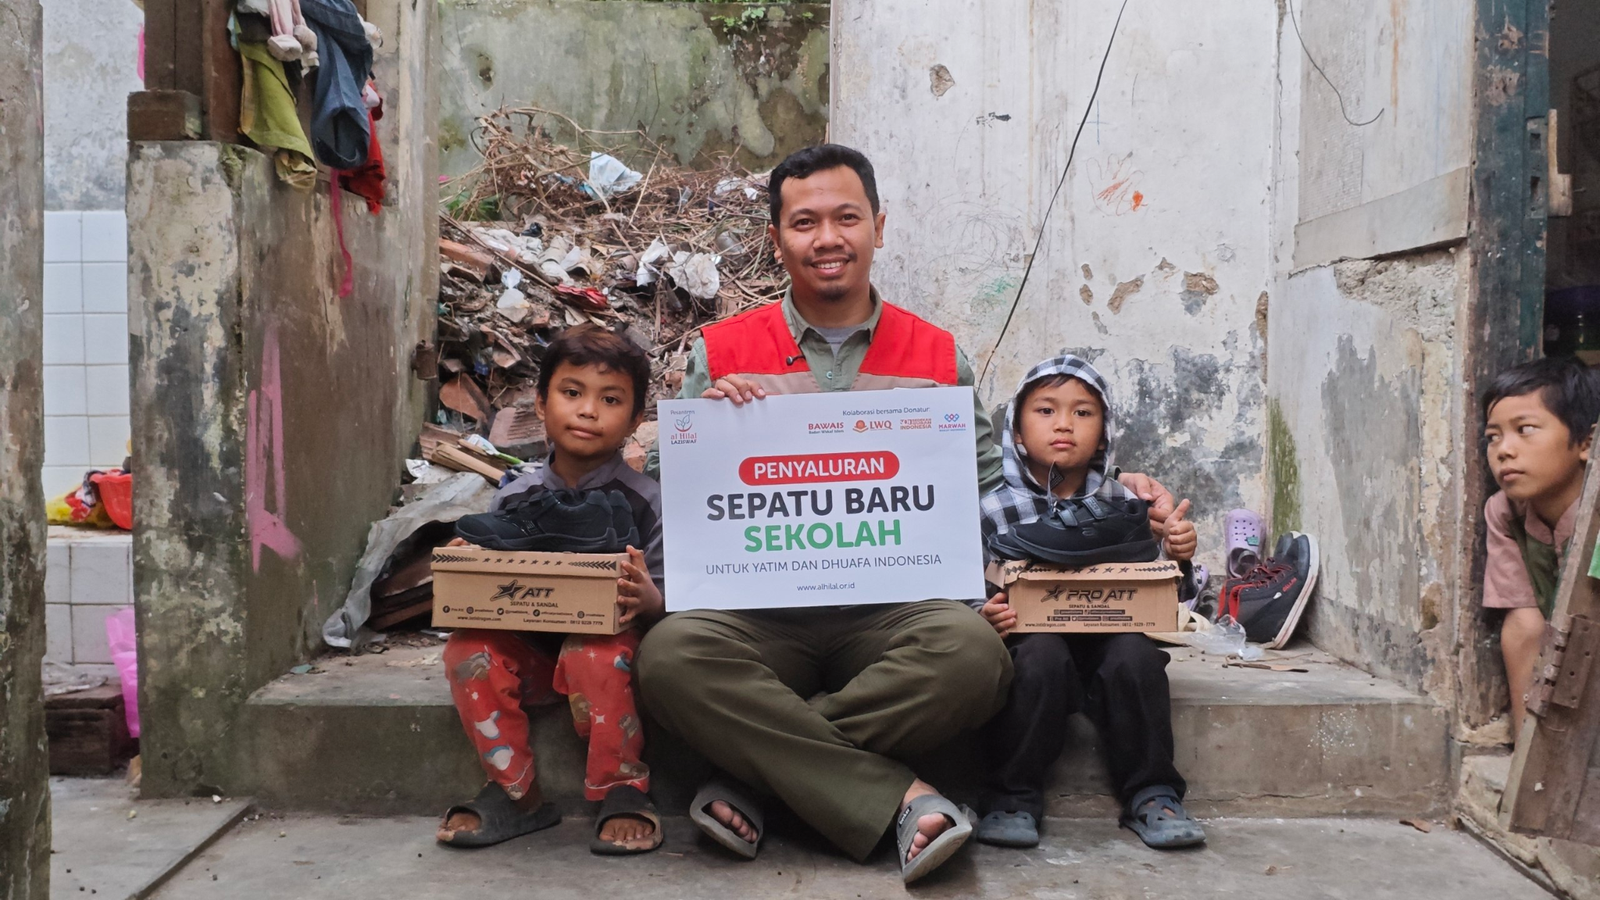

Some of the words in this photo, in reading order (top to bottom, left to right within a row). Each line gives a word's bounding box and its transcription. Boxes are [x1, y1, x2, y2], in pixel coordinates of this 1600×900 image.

[808, 421, 844, 430] BAWAIS
[869, 419, 893, 430] LWQ
[754, 456, 885, 480] PENYALURAN
[706, 489, 833, 521] SEPATU
[845, 484, 935, 515] BARU
[744, 519, 902, 553] SEKOLAH
[706, 563, 750, 575] UNTUK
[752, 561, 788, 573] YATIM
[791, 559, 818, 571] DAN
[821, 557, 871, 570] DHUAFA
[874, 554, 942, 567] INDONESIA
[519, 586, 555, 600] ATT
[796, 582, 855, 591] www.alhilal.or.id
[1066, 588, 1104, 603] PRO
[1103, 588, 1138, 603] ATT
